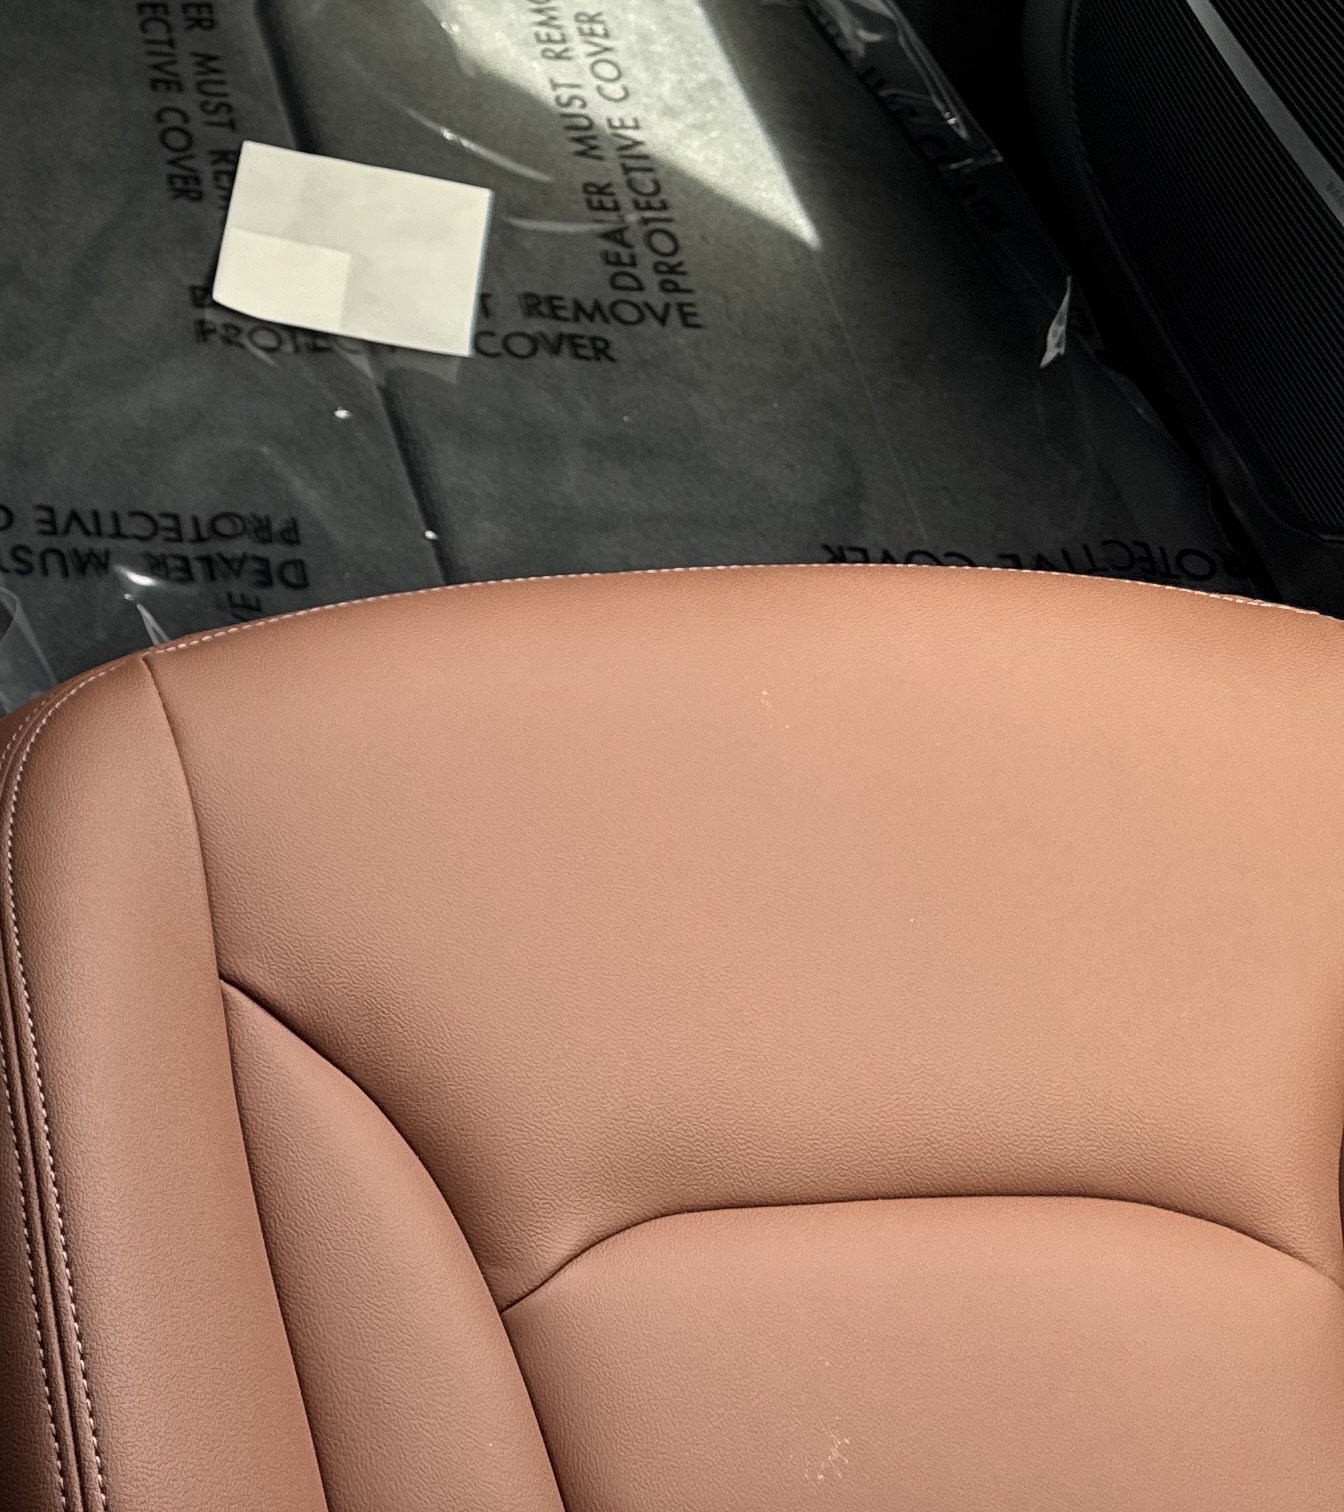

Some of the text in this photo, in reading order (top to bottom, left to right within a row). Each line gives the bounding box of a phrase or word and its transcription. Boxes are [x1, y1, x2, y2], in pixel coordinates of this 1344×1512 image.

[190, 52, 239, 134] MUST
[548, 83, 609, 160] MUST
[154, 110, 205, 202] COVER
[574, 9, 697, 295] PROTECTIVE COVER
[585, 179, 646, 291] DEALER
[474, 330, 616, 362] COVER
[522, 292, 705, 329] REMOVE
[35, 504, 301, 545] PROTECTIVE
[143, 551, 310, 589] DEALER
